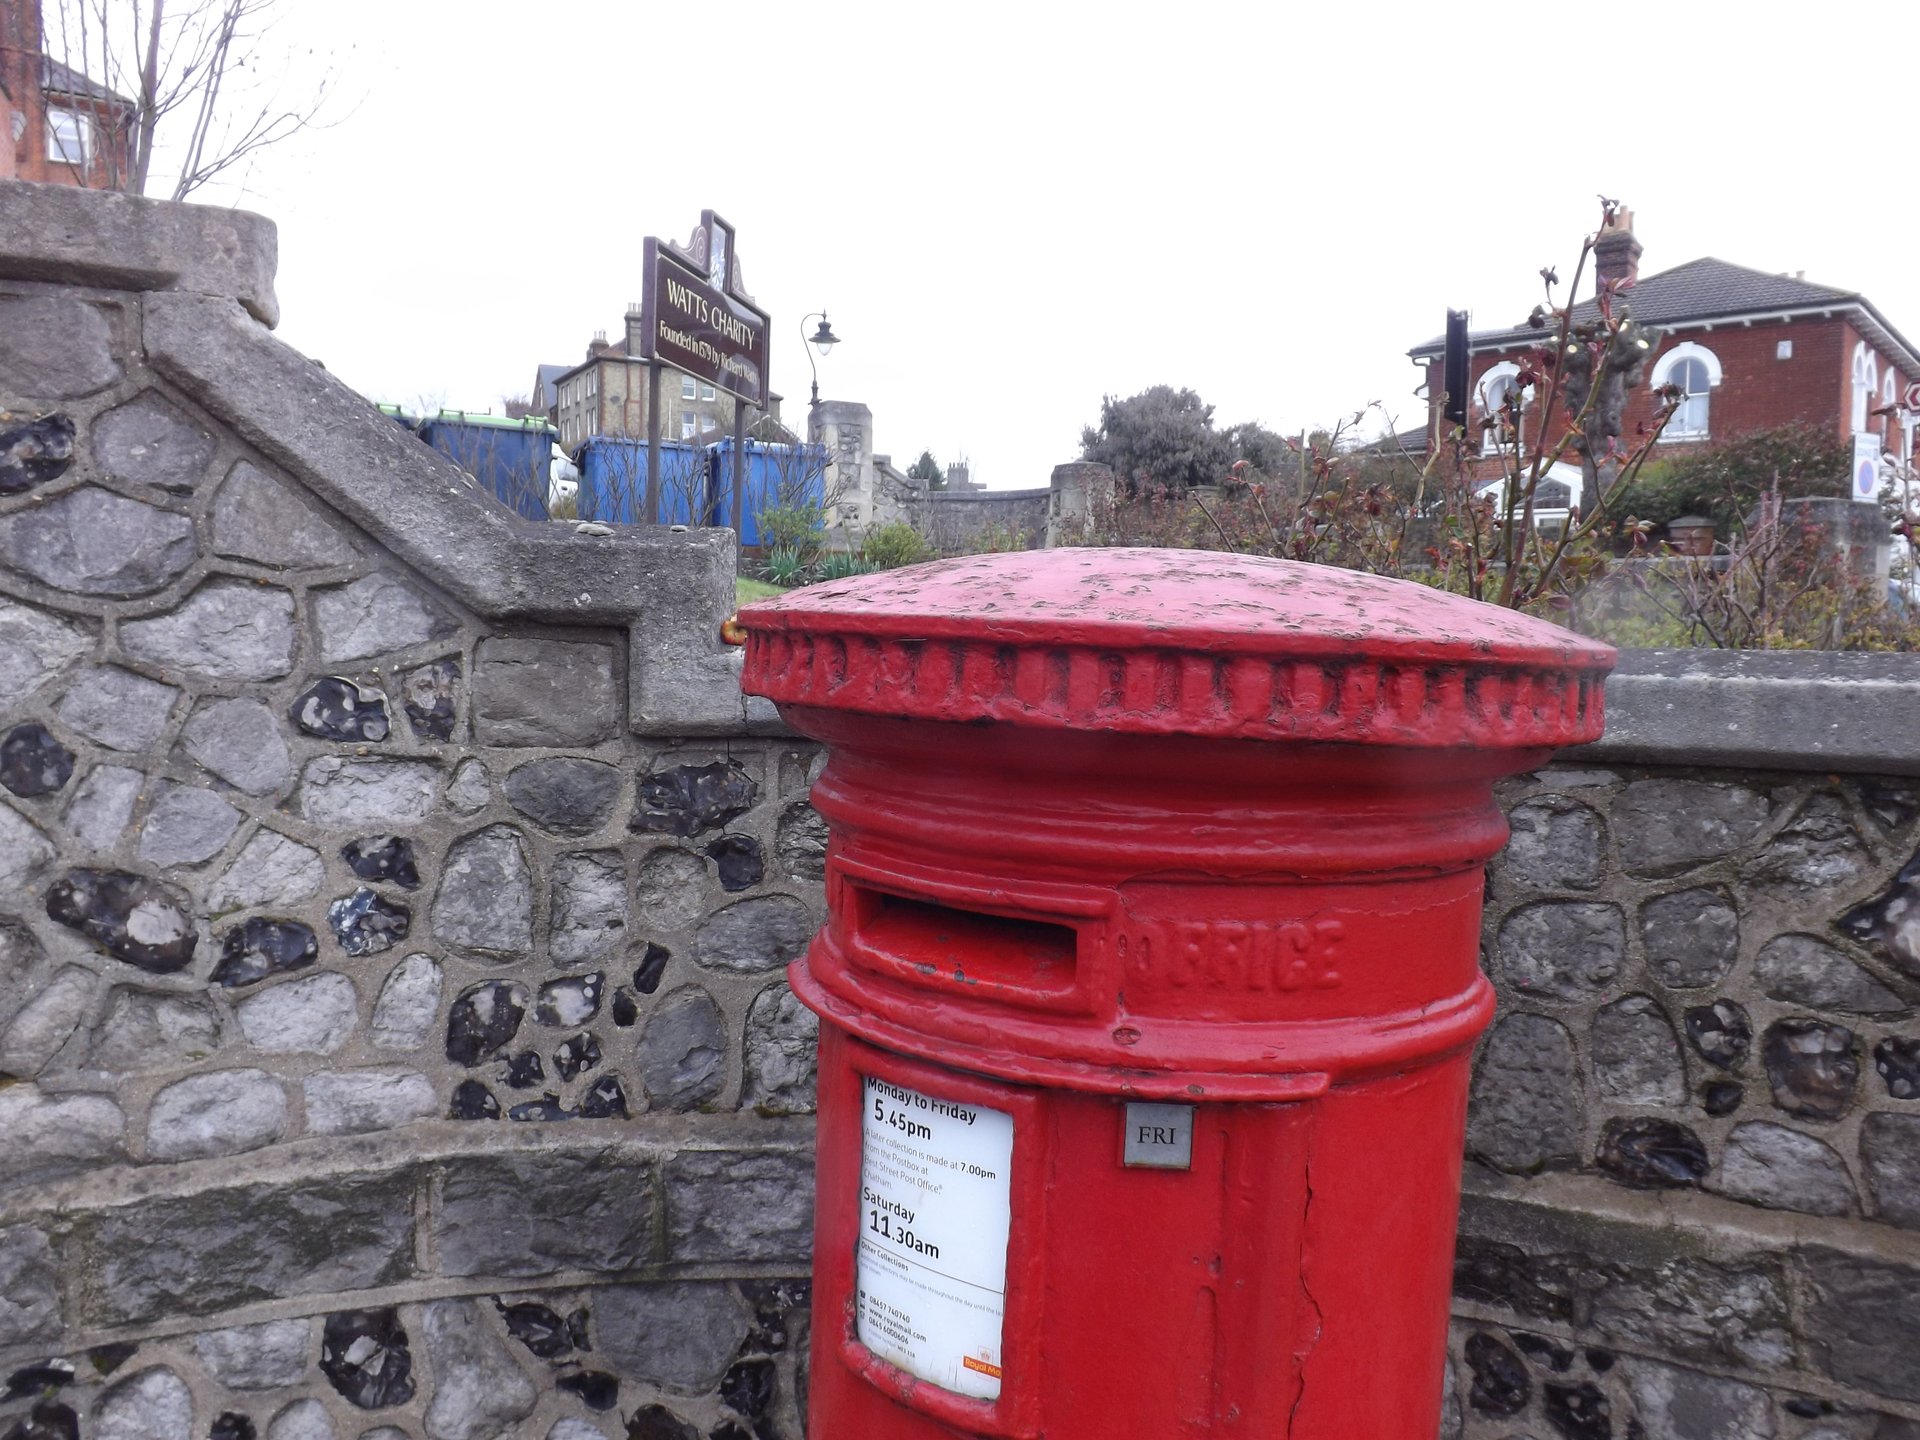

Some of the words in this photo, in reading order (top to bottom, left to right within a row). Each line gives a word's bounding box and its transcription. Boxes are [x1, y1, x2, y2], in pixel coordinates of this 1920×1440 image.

[667, 278, 708, 323] WATTS
[711, 306, 755, 350] CHARITY
[660, 320, 692, 350] Founded
[692, 336, 699, 356] in
[699, 340, 712, 362] 1579
[712, 345, 721, 370] by
[721, 352, 743, 377] Richard
[867, 1077, 912, 1107] Monday
[915, 1095, 928, 1109] to
[931, 1099, 977, 1126] Friday
[874, 1098, 931, 1141] 5.45pm
[1137, 1126, 1177, 1145] FRI
[865, 1141, 880, 1155] from
[880, 1146, 892, 1161] the
[892, 1151, 920, 1172] Postbox
[920, 1166, 928, 1176] at
[870, 1129, 885, 1143] later
[885, 1137, 918, 1158] collection
[918, 1150, 925, 1160] is
[926, 1153, 949, 1168] made
[949, 1159, 959, 1171] at
[960, 1162, 997, 1180] 7.00pm
[878, 1161, 899, 1178] Street
[900, 1170, 916, 1186] Post
[863, 1187, 915, 1224] Saturday
[870, 1209, 940, 1259] 11.30am
[861, 1240, 876, 1254] Other
[876, 1249, 909, 1272] Collections
[868, 1316, 882, 1330] 0845
[869, 1296, 887, 1311] 08457
[888, 1306, 911, 1323] 740740
[869, 1308, 927, 1342] www.royalmail.com
[965, 1357, 987, 1371] Royal
[987, 1366, 1002, 1377] Ma
